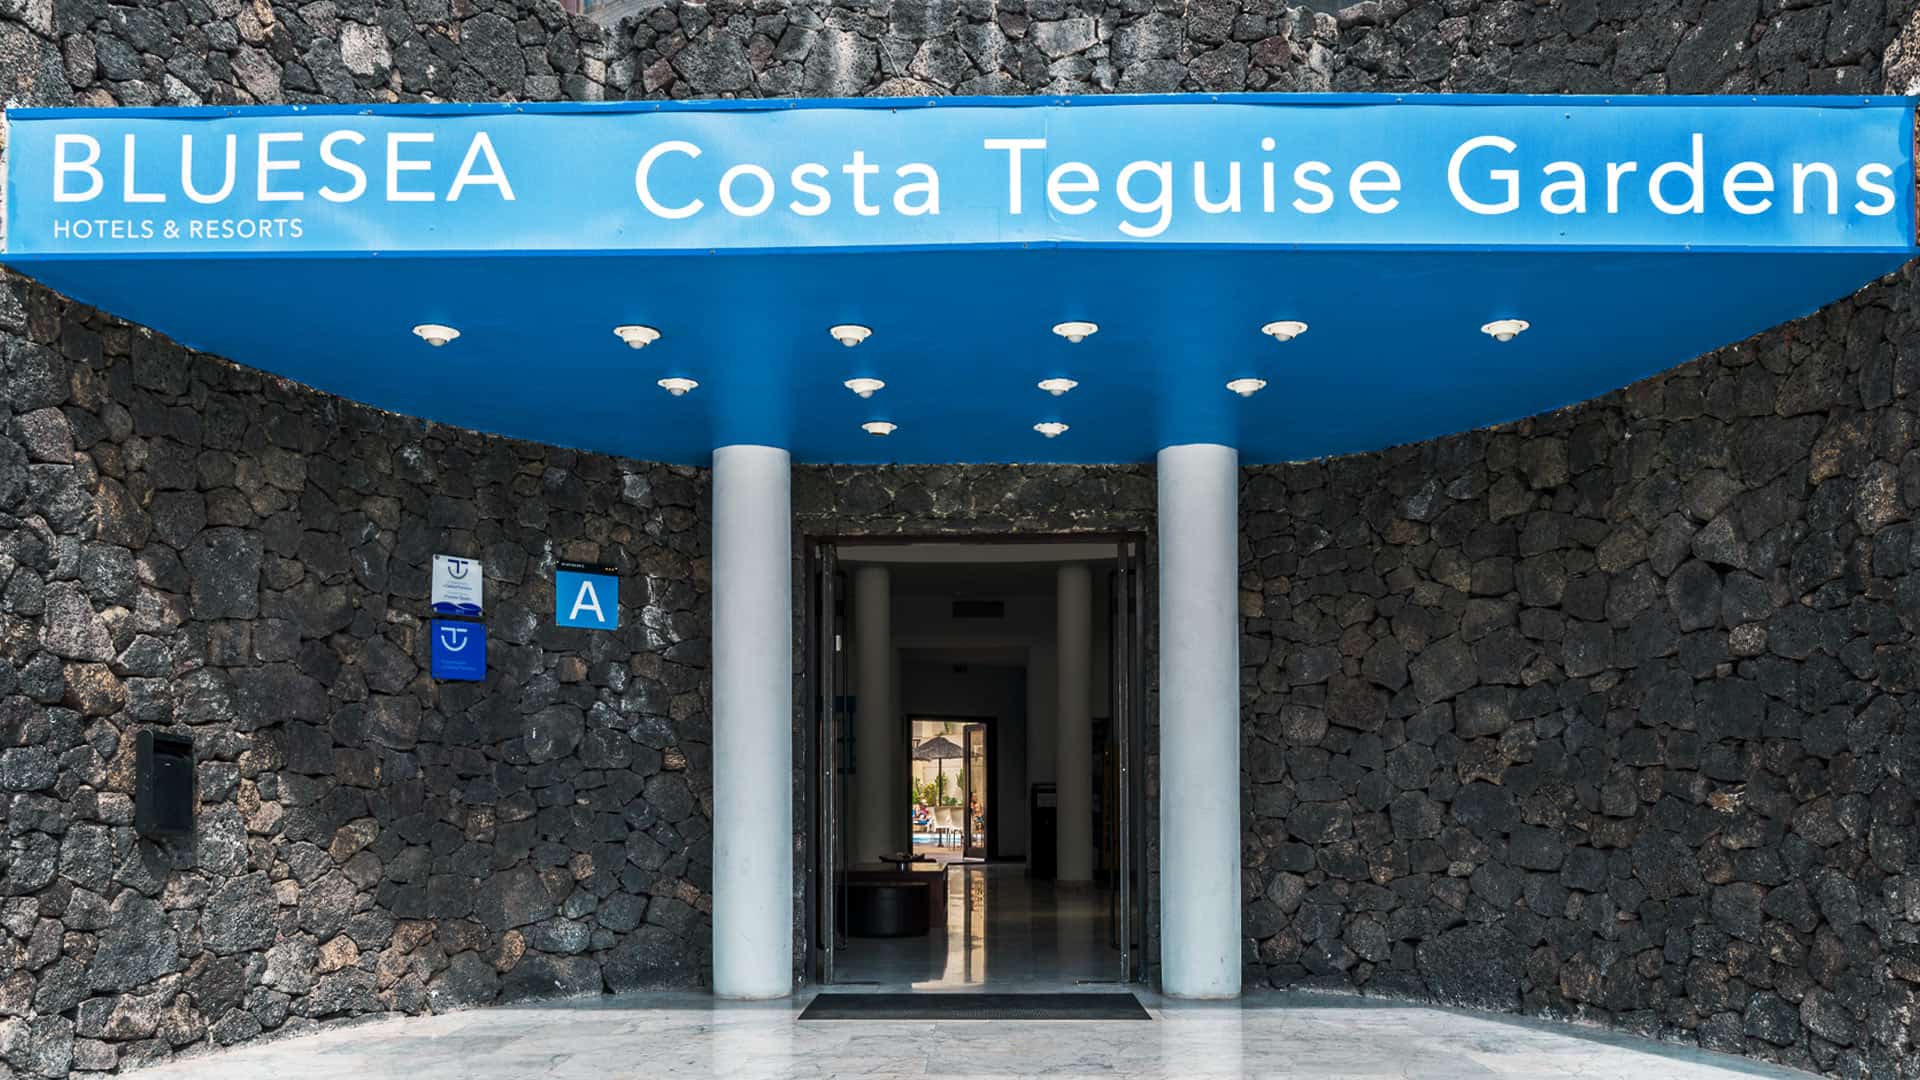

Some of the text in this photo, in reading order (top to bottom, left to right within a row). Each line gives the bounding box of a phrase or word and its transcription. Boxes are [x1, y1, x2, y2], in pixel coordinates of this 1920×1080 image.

[52, 130, 516, 203] BLUESEA
[635, 132, 1896, 238] Costa Teguise Gardens
[52, 218, 304, 239] HOTELS & RESORTS
[568, 580, 606, 623] A
